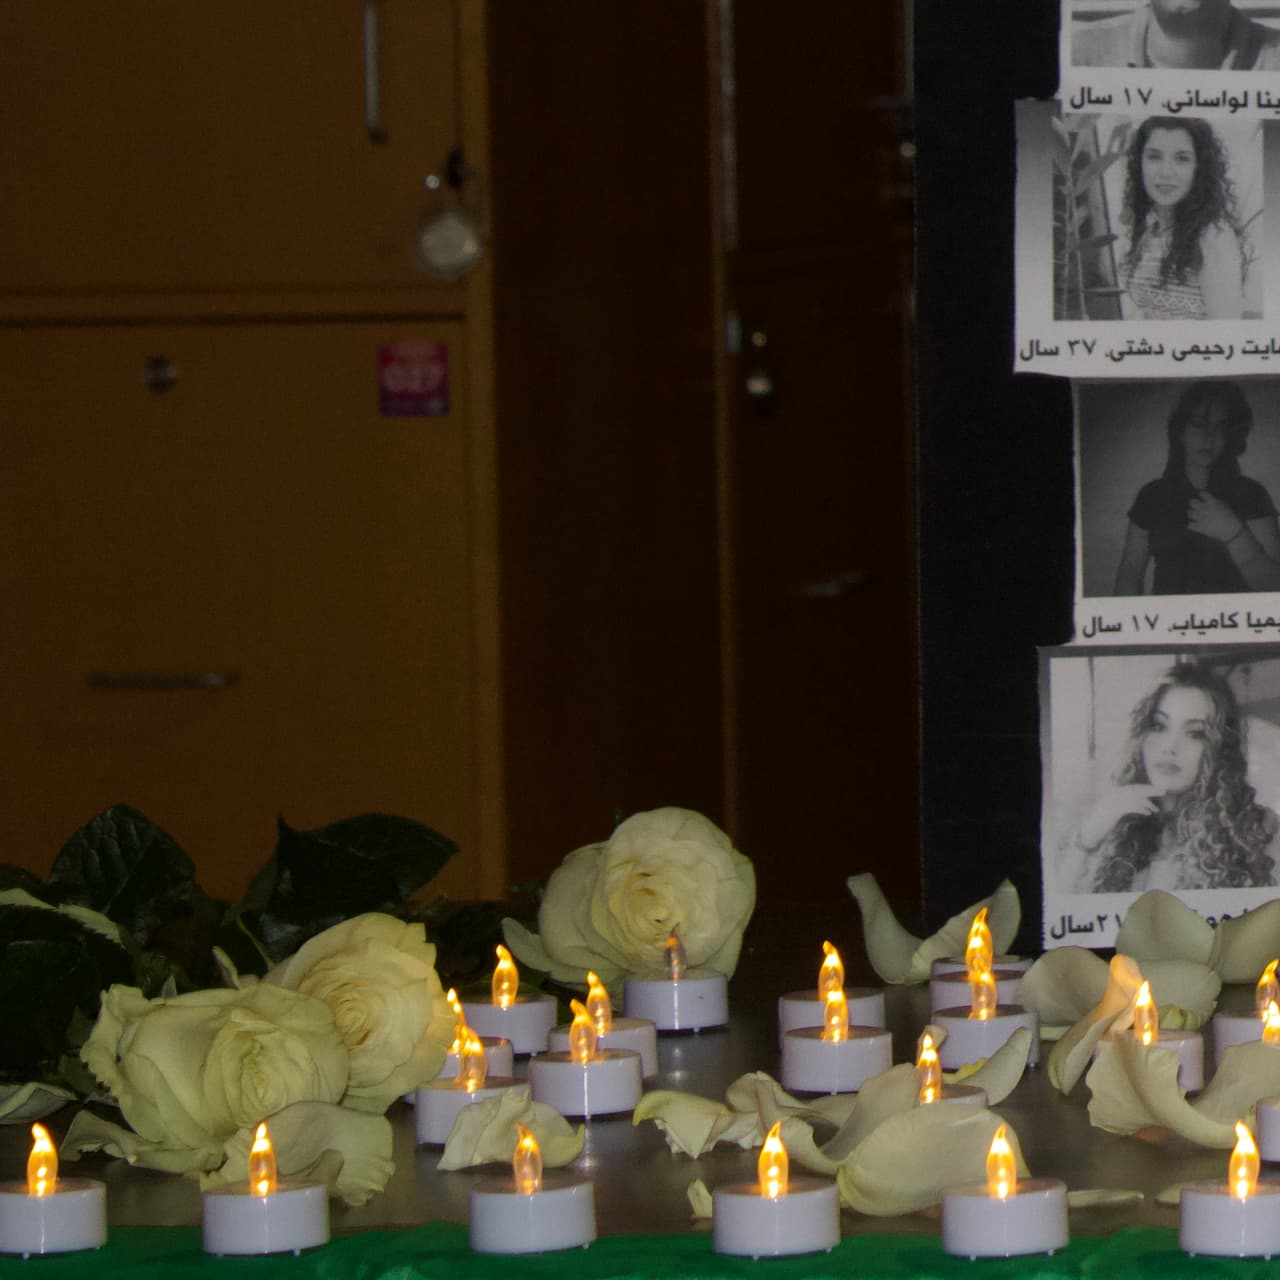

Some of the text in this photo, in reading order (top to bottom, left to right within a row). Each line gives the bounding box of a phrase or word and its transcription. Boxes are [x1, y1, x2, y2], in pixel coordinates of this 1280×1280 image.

[1070, 87, 1112, 109] سال
[1124, 88, 1152, 104] ۱۷
[1020, 340, 1059, 361] سال
[1172, 344, 1234, 362] رحیمی
[1082, 616, 1122, 638] سال
[1132, 615, 1158, 630] ۱۷
